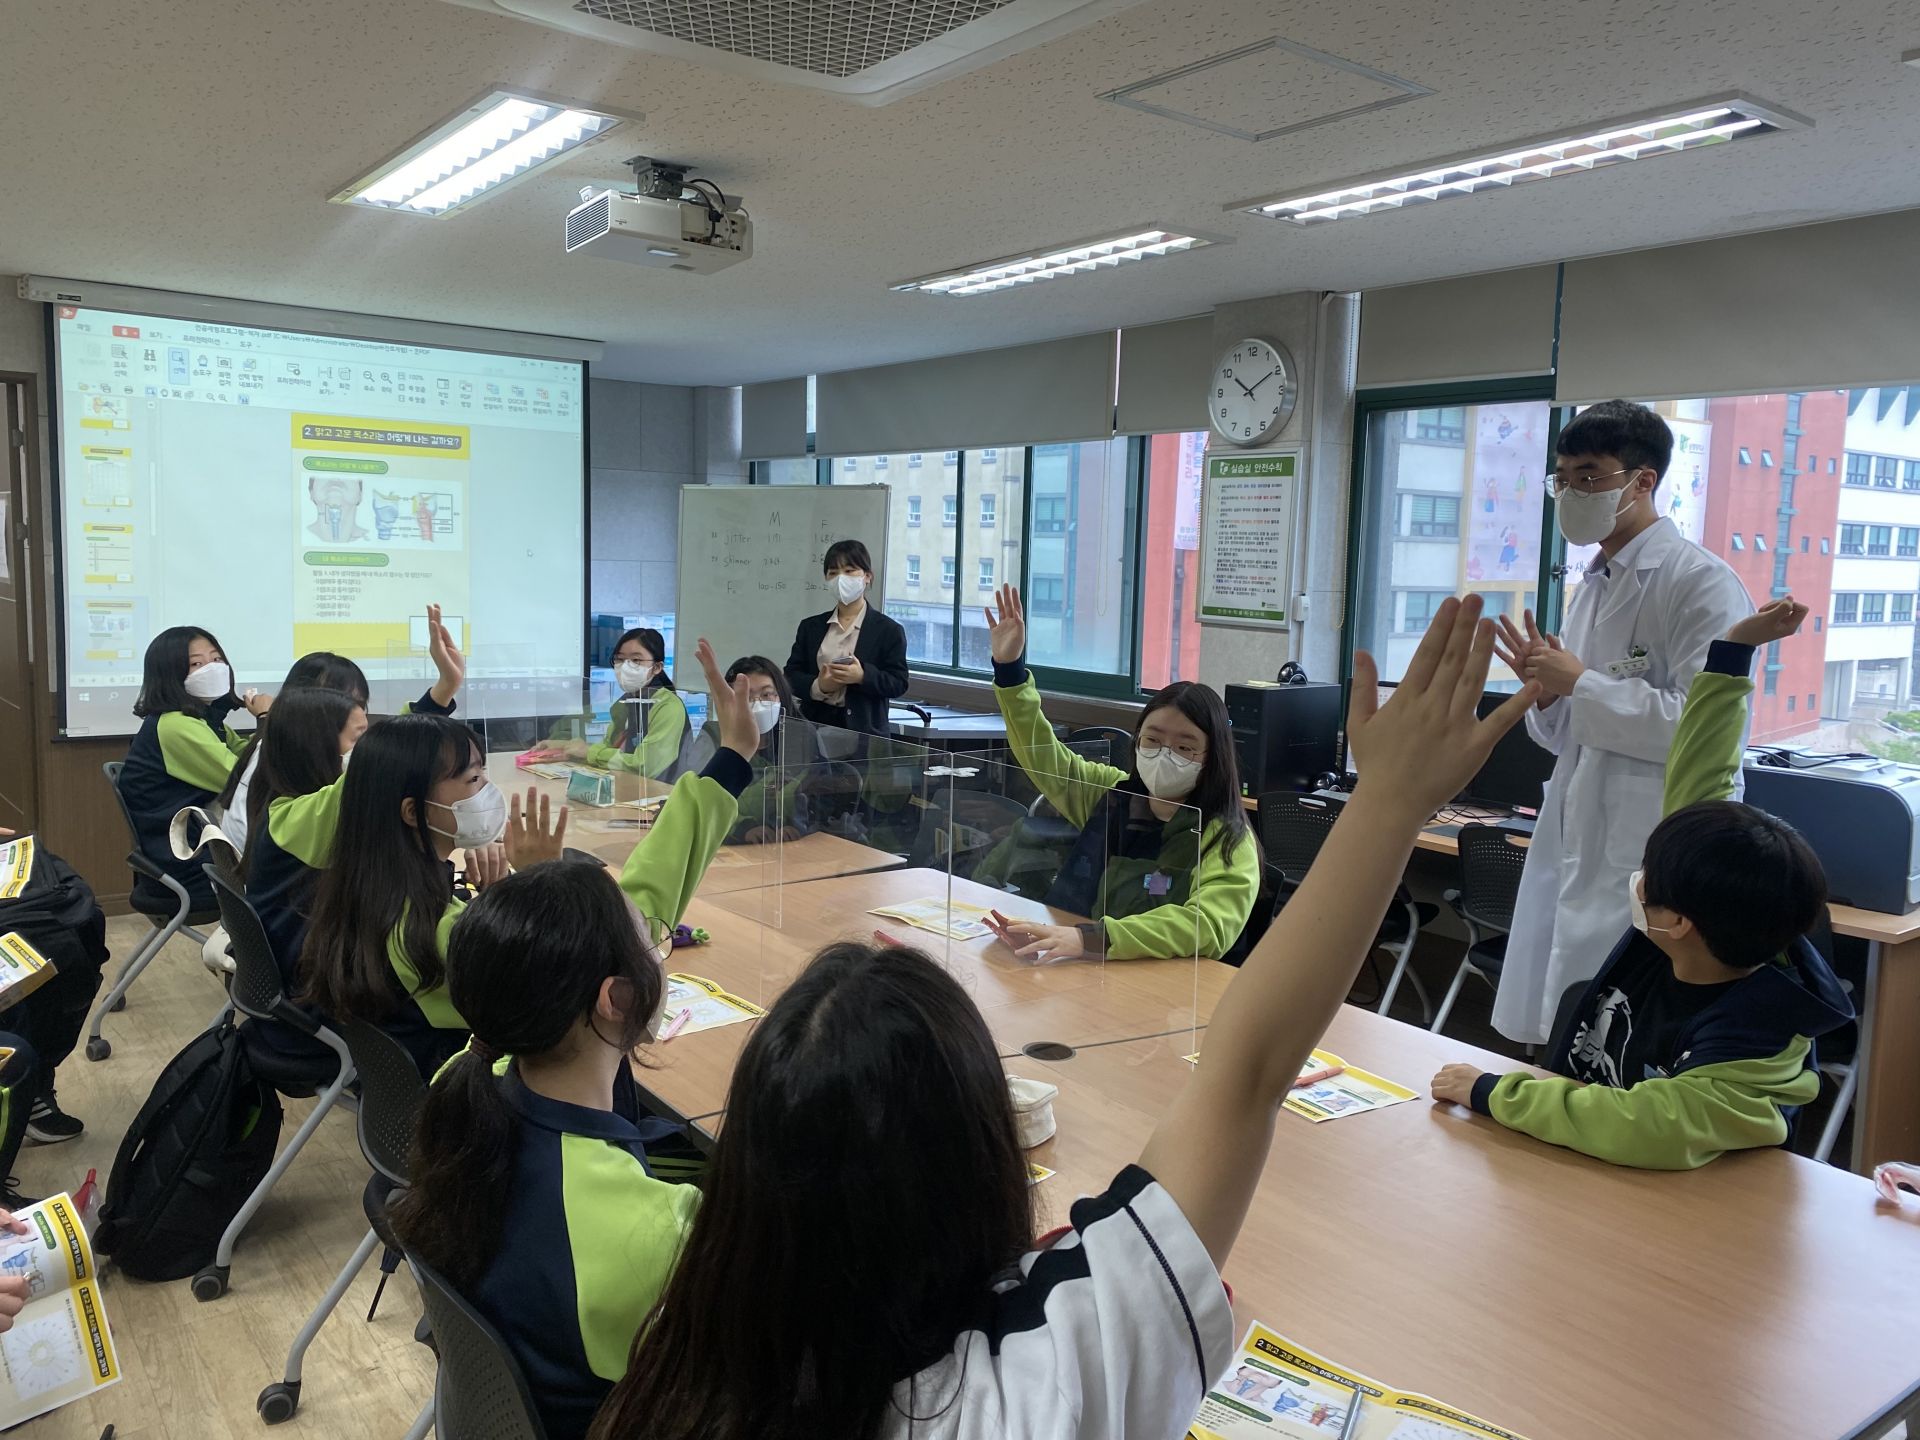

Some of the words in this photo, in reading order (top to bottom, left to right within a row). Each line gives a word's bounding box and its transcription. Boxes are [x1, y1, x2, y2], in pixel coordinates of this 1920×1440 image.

[1247, 346, 1258, 357] 12
[1265, 351, 1270, 361] 1
[1233, 353, 1242, 363] 11
[1222, 368, 1233, 379] 10
[1274, 365, 1281, 376] 2
[1217, 388, 1224, 398] 9
[1278, 385, 1284, 396] 3
[1221, 408, 1227, 418] 8
[1272, 406, 1279, 414] 4
[1231, 422, 1237, 432] 7
[1259, 421, 1266, 431] 5
[314, 427, 332, 437] 맑고
[335, 429, 352, 439] 고운
[353, 430, 385, 441] 목소리는
[386, 433, 411, 443] 어떻게
[413, 435, 429, 445] 나는
[1244, 427, 1251, 437] 6
[1231, 463, 1252, 474] 실습실
[1254, 462, 1283, 473] 안전수칙
[769, 511, 781, 527] M
[821, 519, 829, 529] F
[1294, 1357, 1319, 1373] 목소리는
[1319, 1369, 1341, 1381] 어떻게
